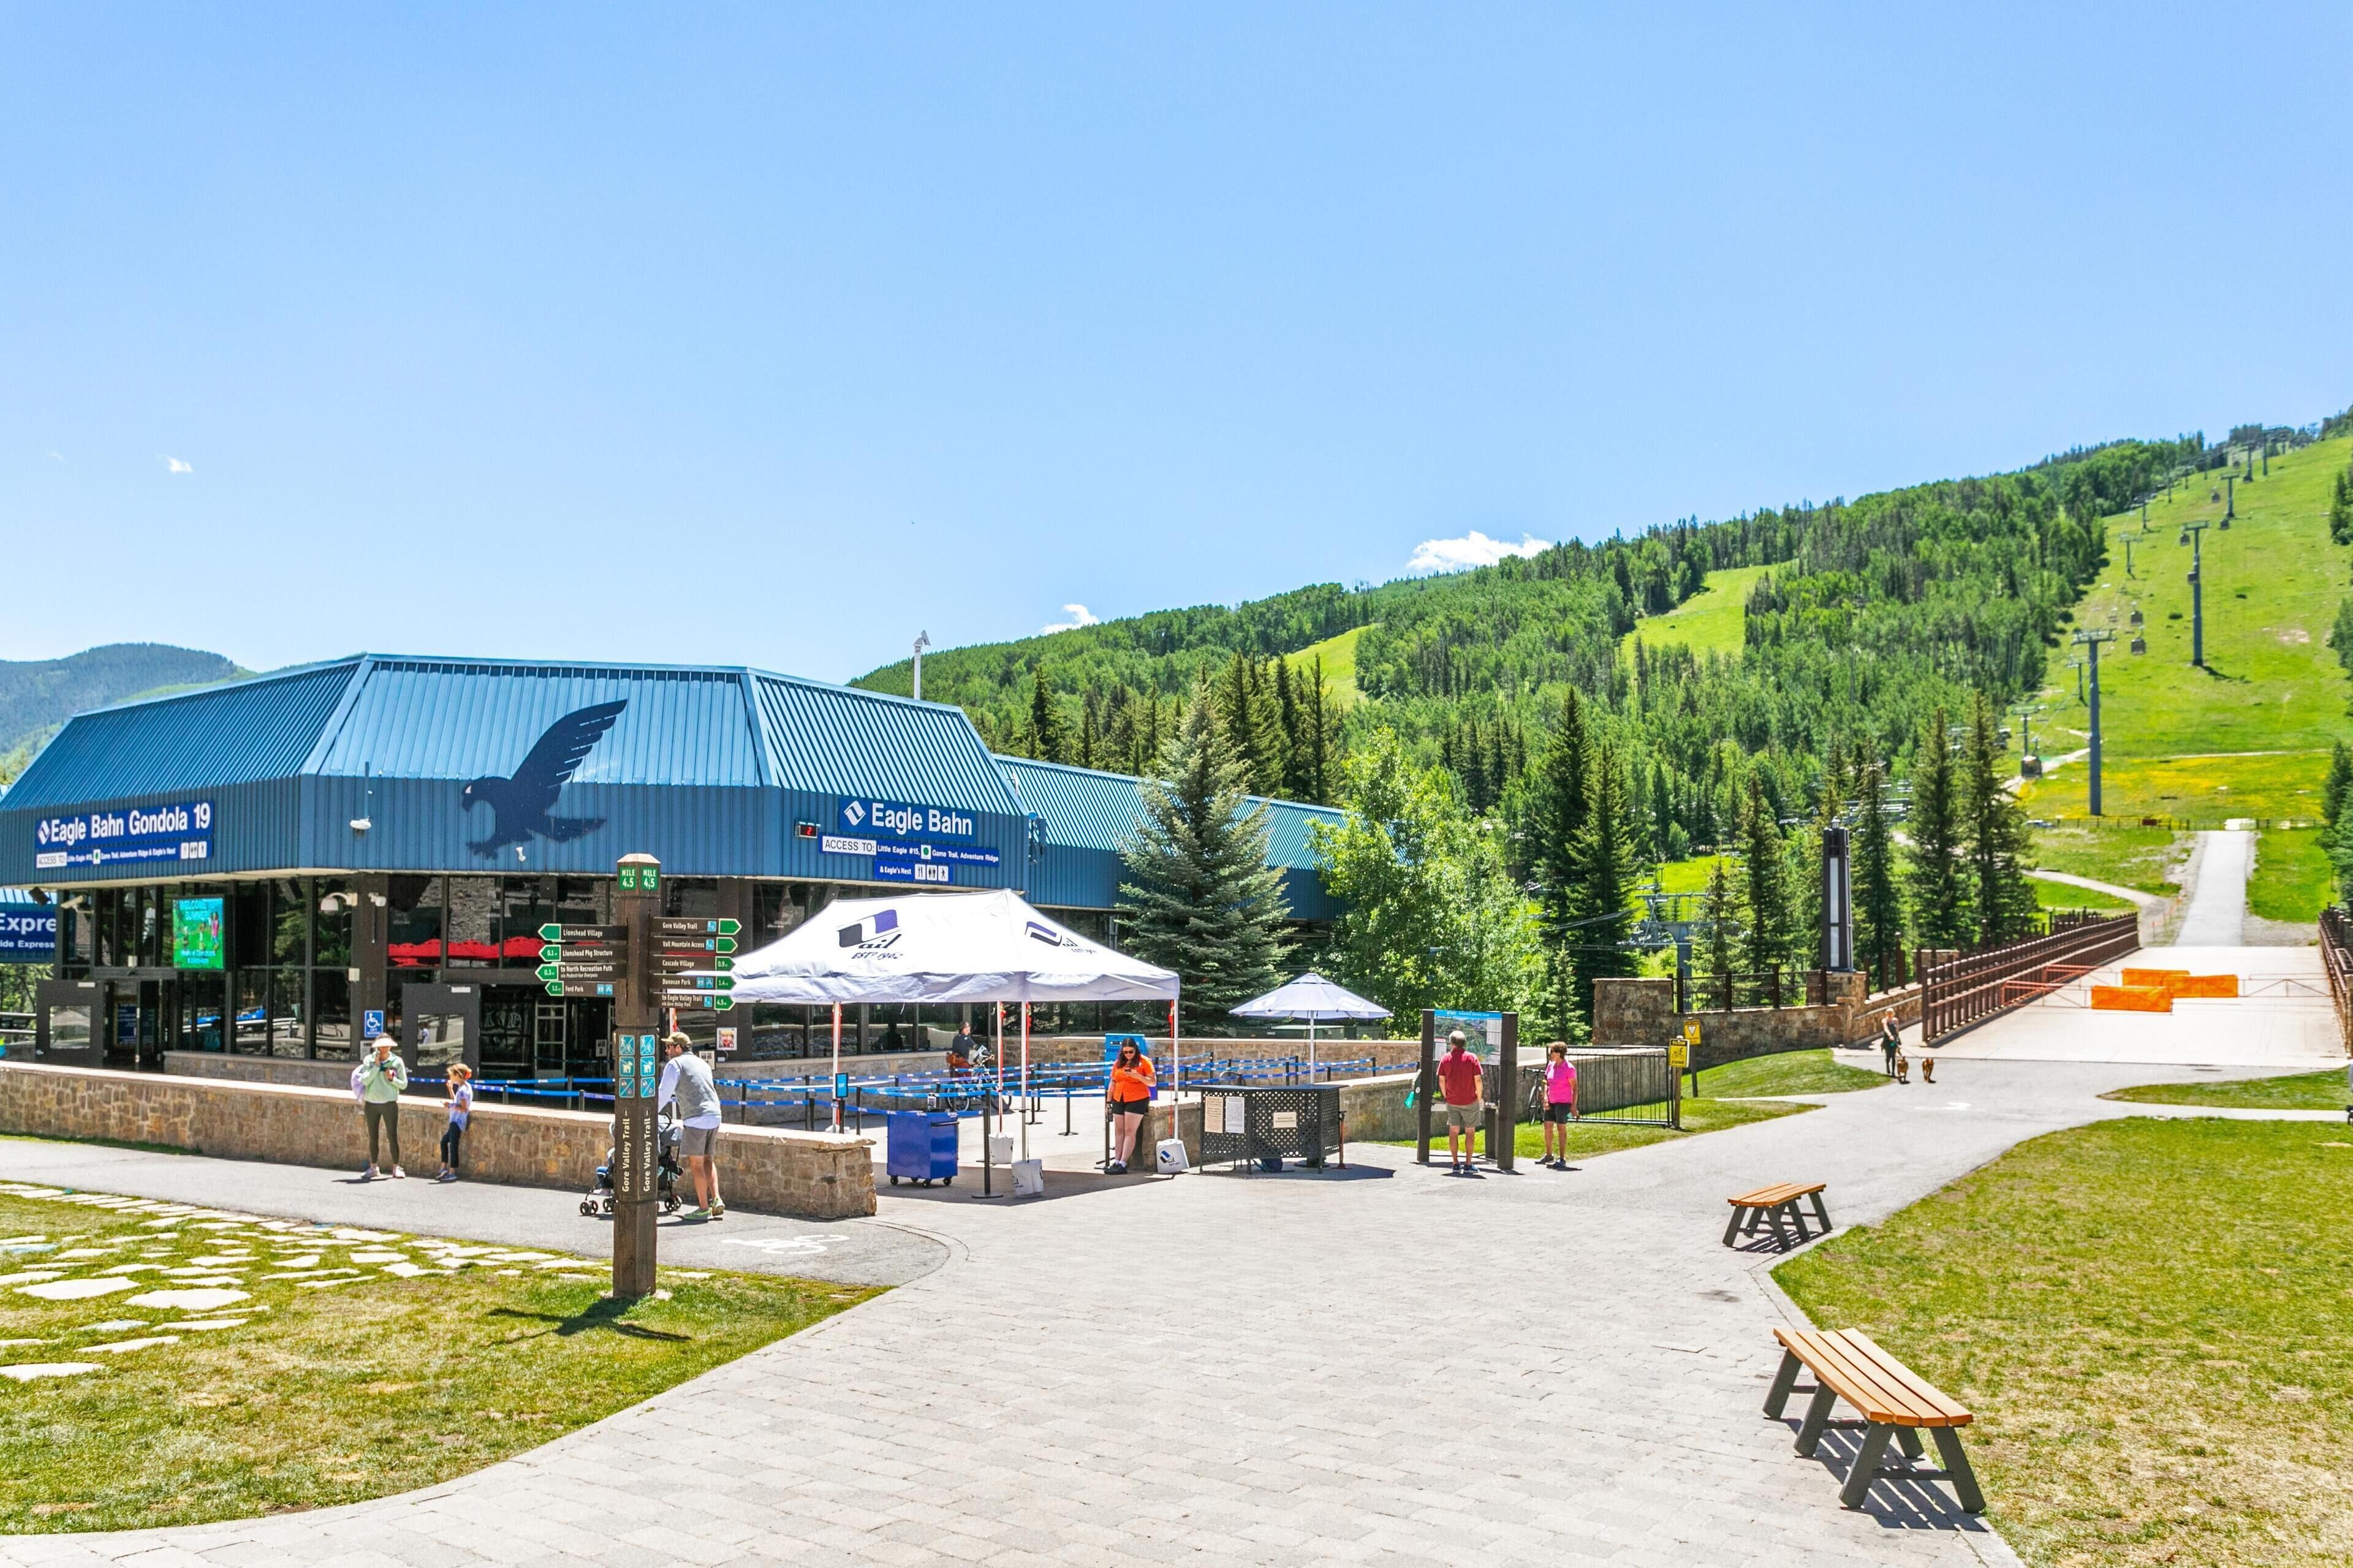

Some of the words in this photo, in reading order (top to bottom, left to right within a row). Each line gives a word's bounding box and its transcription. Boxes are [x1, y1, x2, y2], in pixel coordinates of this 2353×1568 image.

[51, 817, 86, 846] Eagle
[92, 813, 124, 839] Bahn
[129, 806, 188, 835] Gondola
[194, 803, 211, 829] 19
[872, 803, 922, 835] Eagle
[928, 809, 972, 835] Bahn
[825, 839, 858, 851] ACCESS
[862, 842, 874, 852] TO:
[884, 866, 900, 875] Eagle's
[623, 877, 634, 887] 4.5
[643, 877, 655, 888] 4.5
[587, 929, 603, 938] Village
[18, 940, 55, 949] Express
[623, 1142, 631, 1169] Valley
[643, 1141, 652, 1169] Valley
